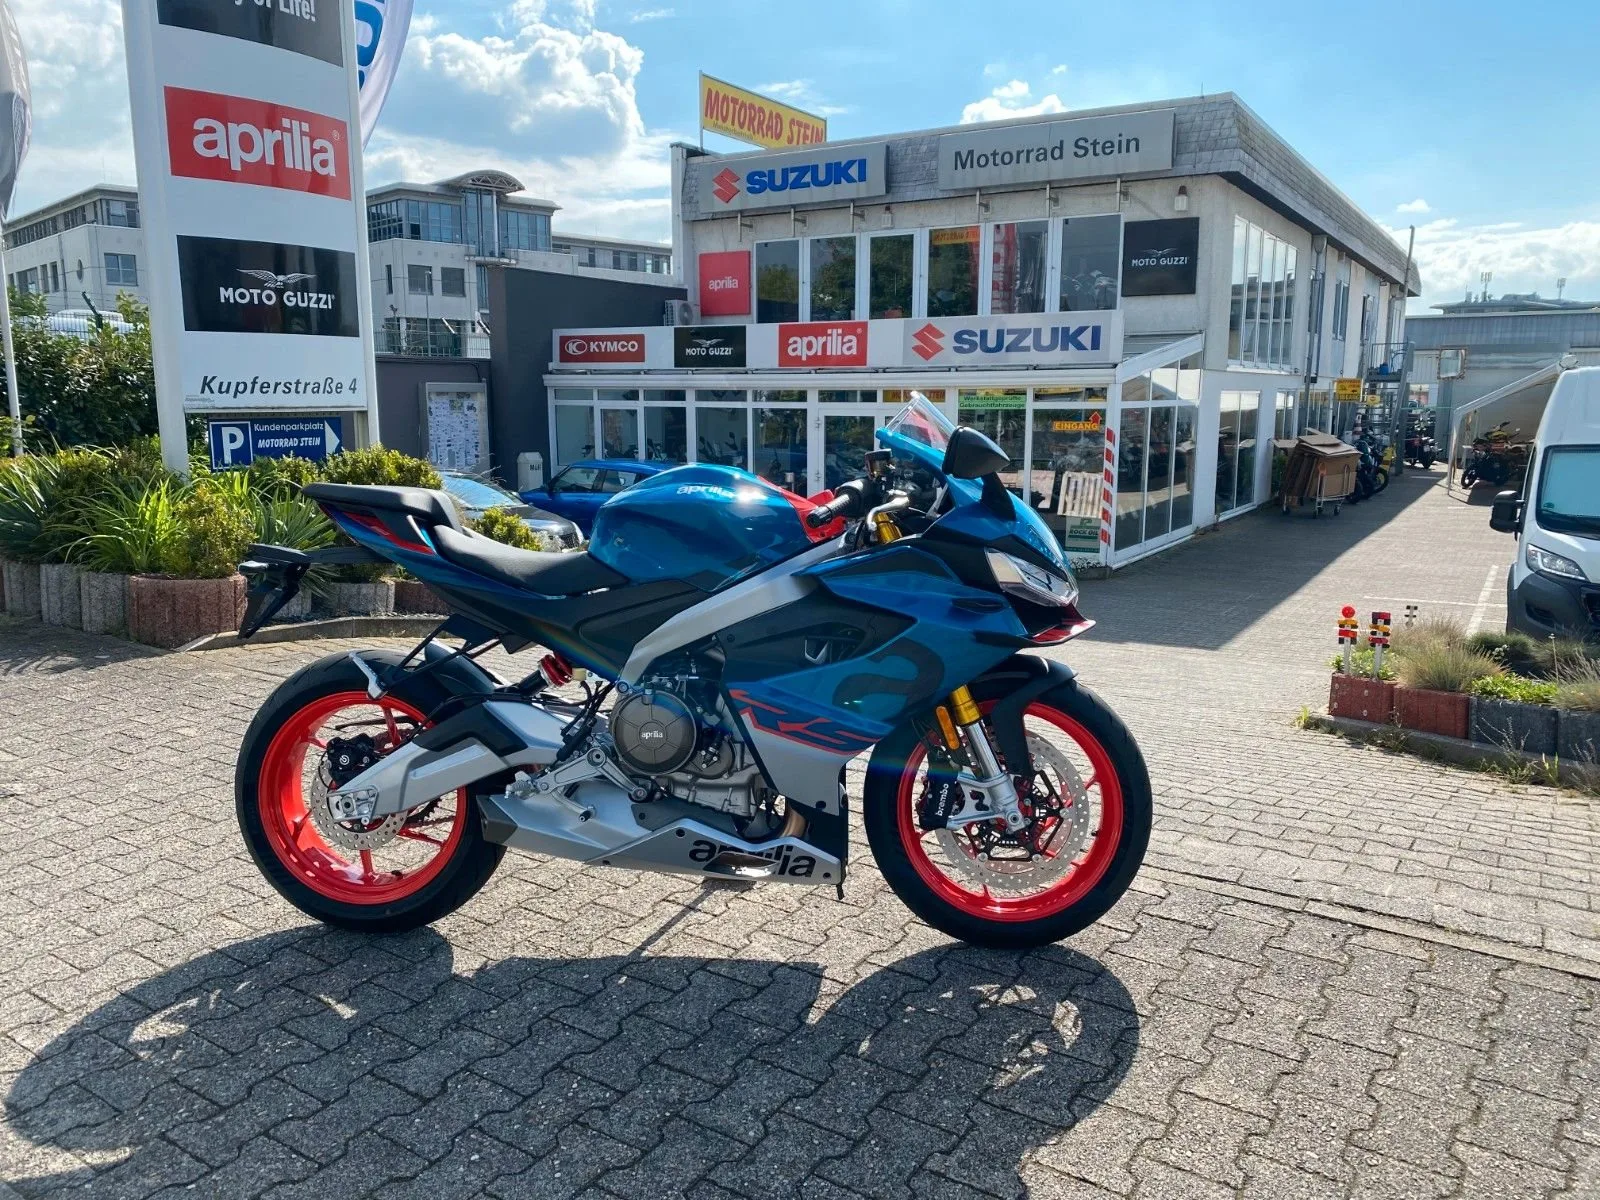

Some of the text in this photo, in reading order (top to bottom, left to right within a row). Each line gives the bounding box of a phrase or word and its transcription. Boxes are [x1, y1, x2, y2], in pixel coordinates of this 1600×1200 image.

[704, 87, 784, 141] MOTORRAD
[787, 118, 824, 146] STEIN
[192, 117, 336, 177] aprilia
[954, 133, 1140, 171] Motorrad Stein
[746, 158, 867, 194] SUZUKI
[1131, 256, 1188, 267] MOTO GUZZI
[708, 275, 739, 292] aprilia
[219, 287, 334, 309] MOTO GUZZI
[589, 340, 639, 353] KYMCO
[685, 346, 732, 356] MOTO GUZZI
[787, 328, 858, 361] aprilia
[952, 325, 1102, 355] SUZUKI
[200, 375, 358, 399] Kupferstraße 4
[253, 421, 324, 433] Kundenparkplatz
[1055, 422, 1098, 430] EINGANG
[221, 426, 245, 464] P
[257, 437, 321, 449] MOTORRAD STEIN
[641, 730, 664, 740] aprilia
[935, 783, 950, 817] brembo
